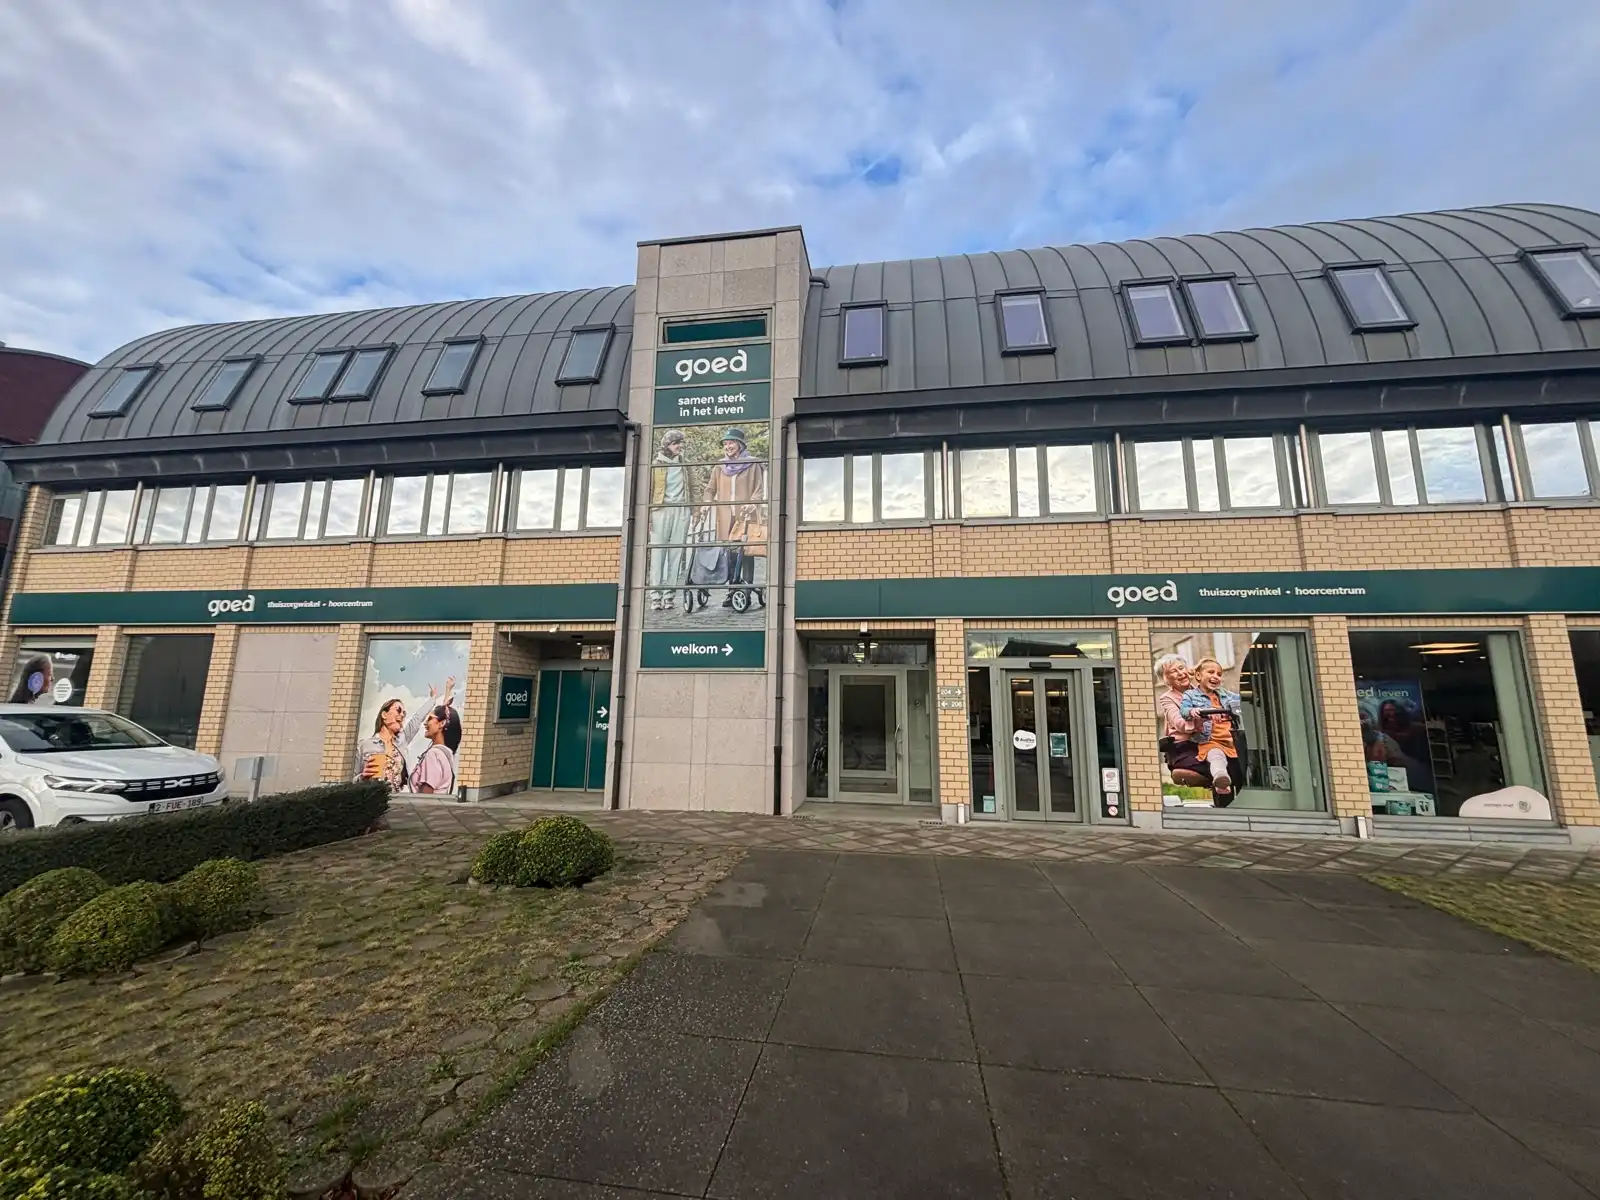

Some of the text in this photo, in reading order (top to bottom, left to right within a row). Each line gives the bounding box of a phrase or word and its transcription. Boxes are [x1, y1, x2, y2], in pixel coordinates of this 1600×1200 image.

[675, 349, 747, 382] goed
[677, 392, 746, 405] samen sterk
[679, 405, 744, 416] in het leven
[1107, 580, 1366, 608] goed thuiszorgwinkel hoorcentrum
[207, 594, 373, 617] goed thuiszorgwinkel hoorcentrum
[670, 643, 718, 655] welkom
[505, 690, 528, 706] goed
[1377, 689, 1409, 697] leven
